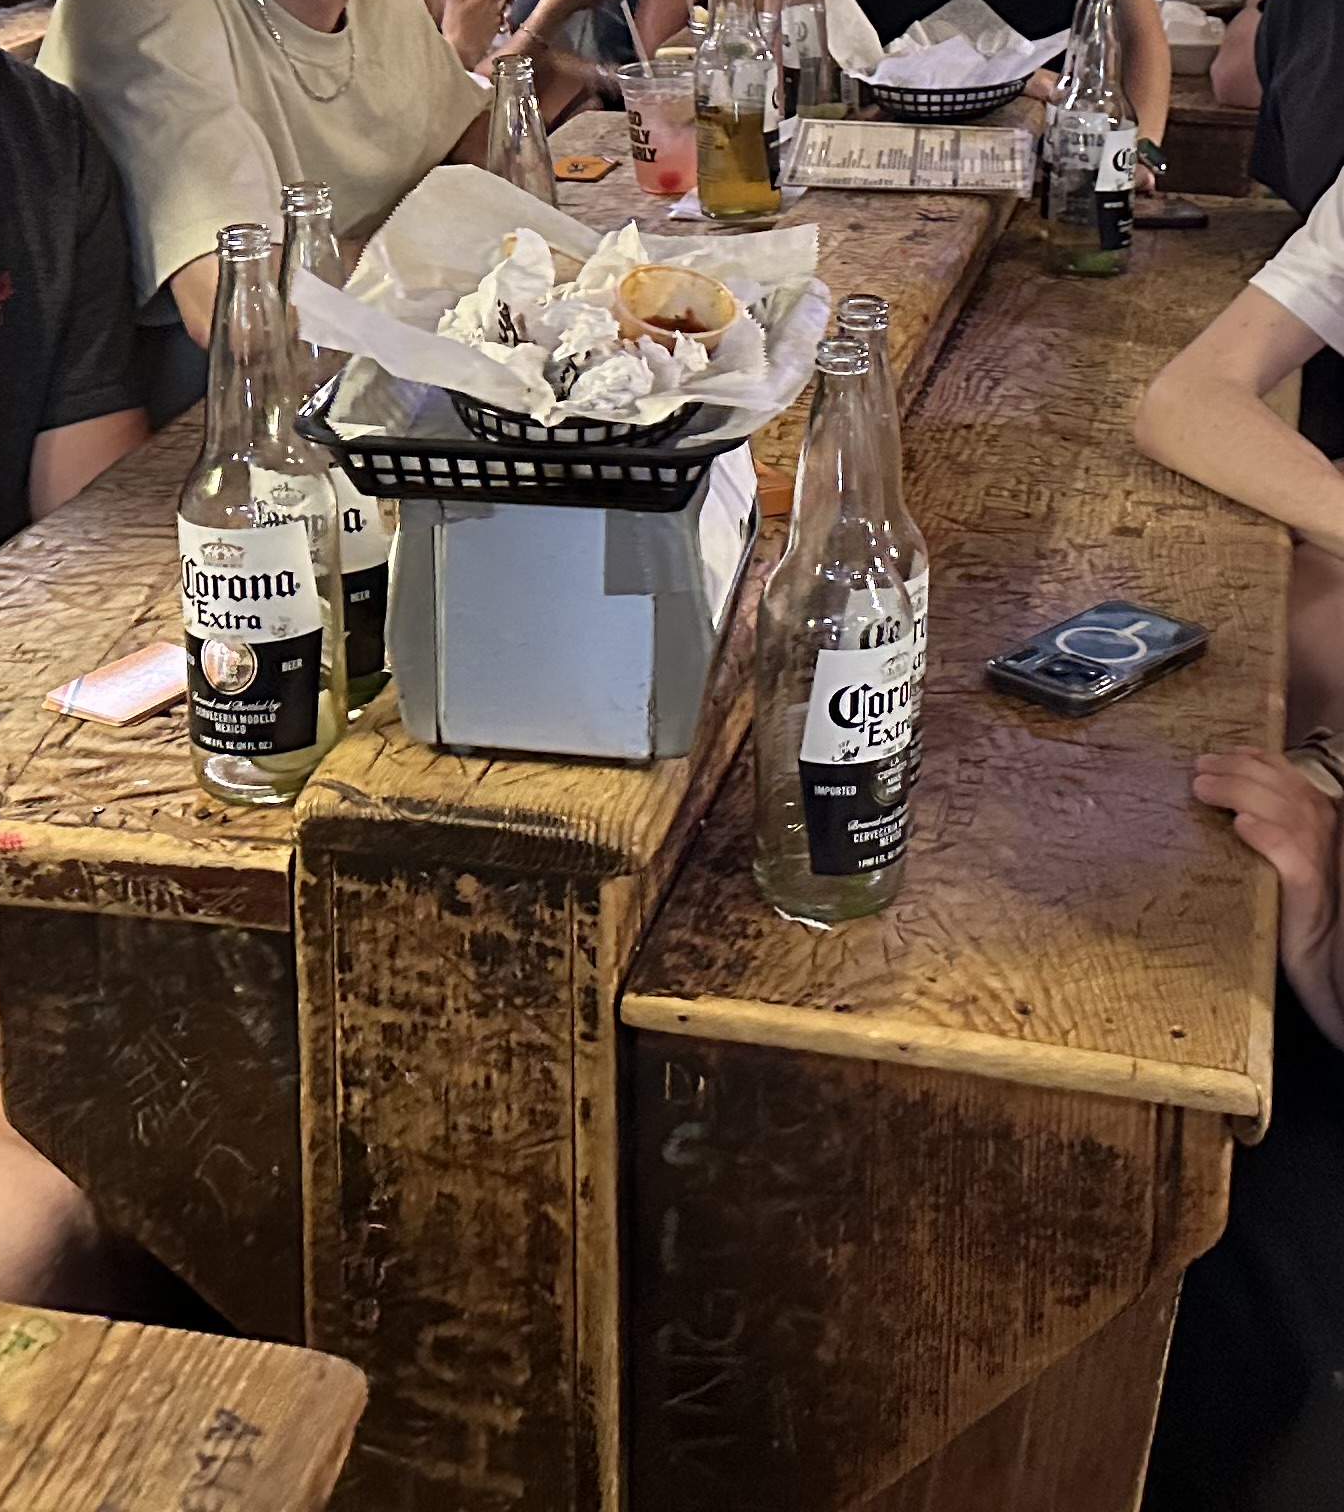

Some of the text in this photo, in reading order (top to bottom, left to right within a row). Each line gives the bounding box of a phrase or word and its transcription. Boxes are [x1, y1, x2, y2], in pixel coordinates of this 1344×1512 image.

[181, 555, 301, 603] Corona
[192, 600, 263, 630] Extra
[239, 712, 277, 725] MODELO
